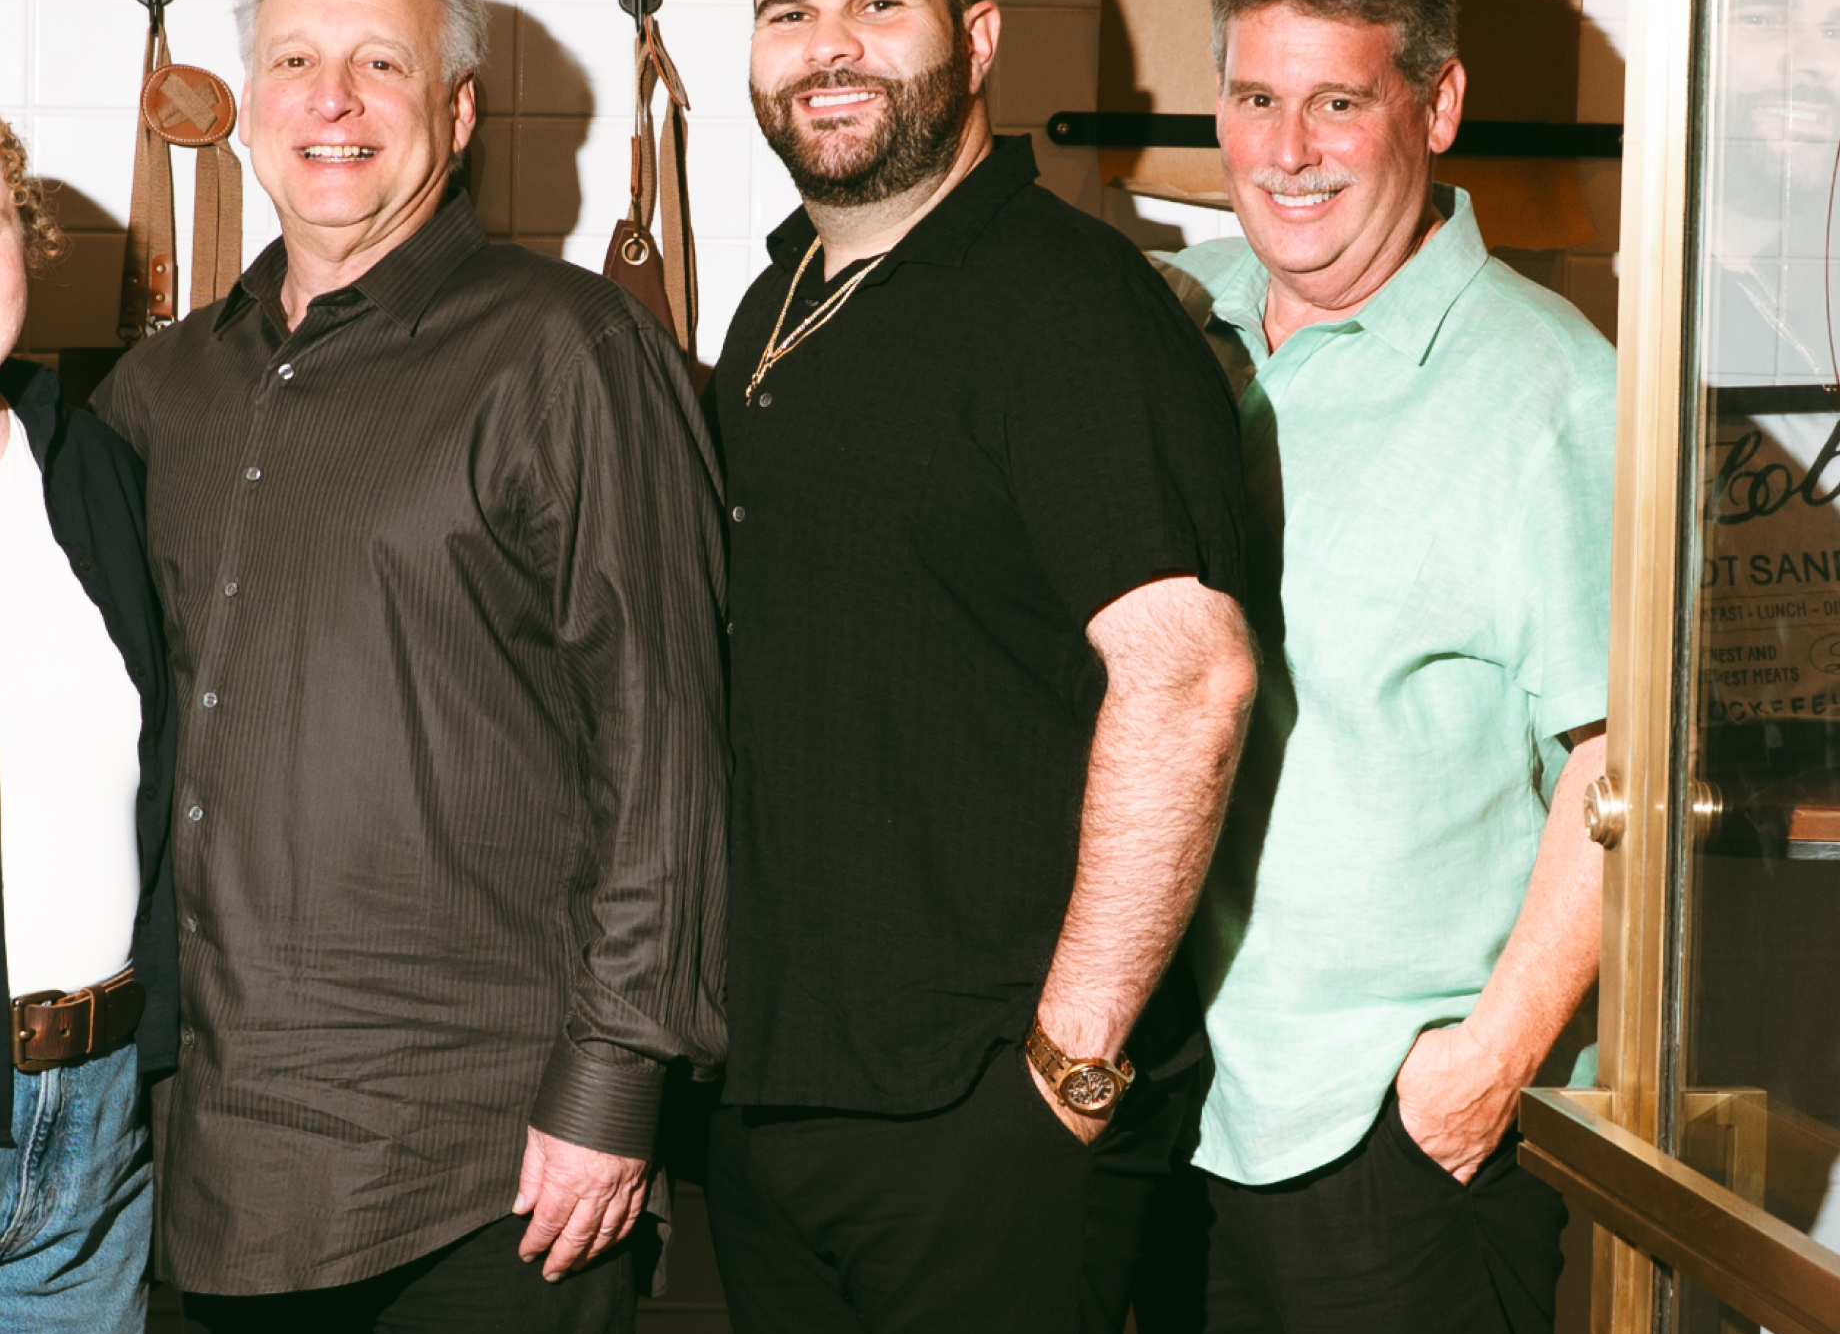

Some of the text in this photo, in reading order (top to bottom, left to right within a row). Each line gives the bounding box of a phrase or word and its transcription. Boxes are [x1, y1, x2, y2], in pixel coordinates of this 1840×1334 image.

[1757, 601, 1807, 620] LUNCH
[1747, 645, 1777, 662] AND
[1752, 666, 1799, 685] MEATS
